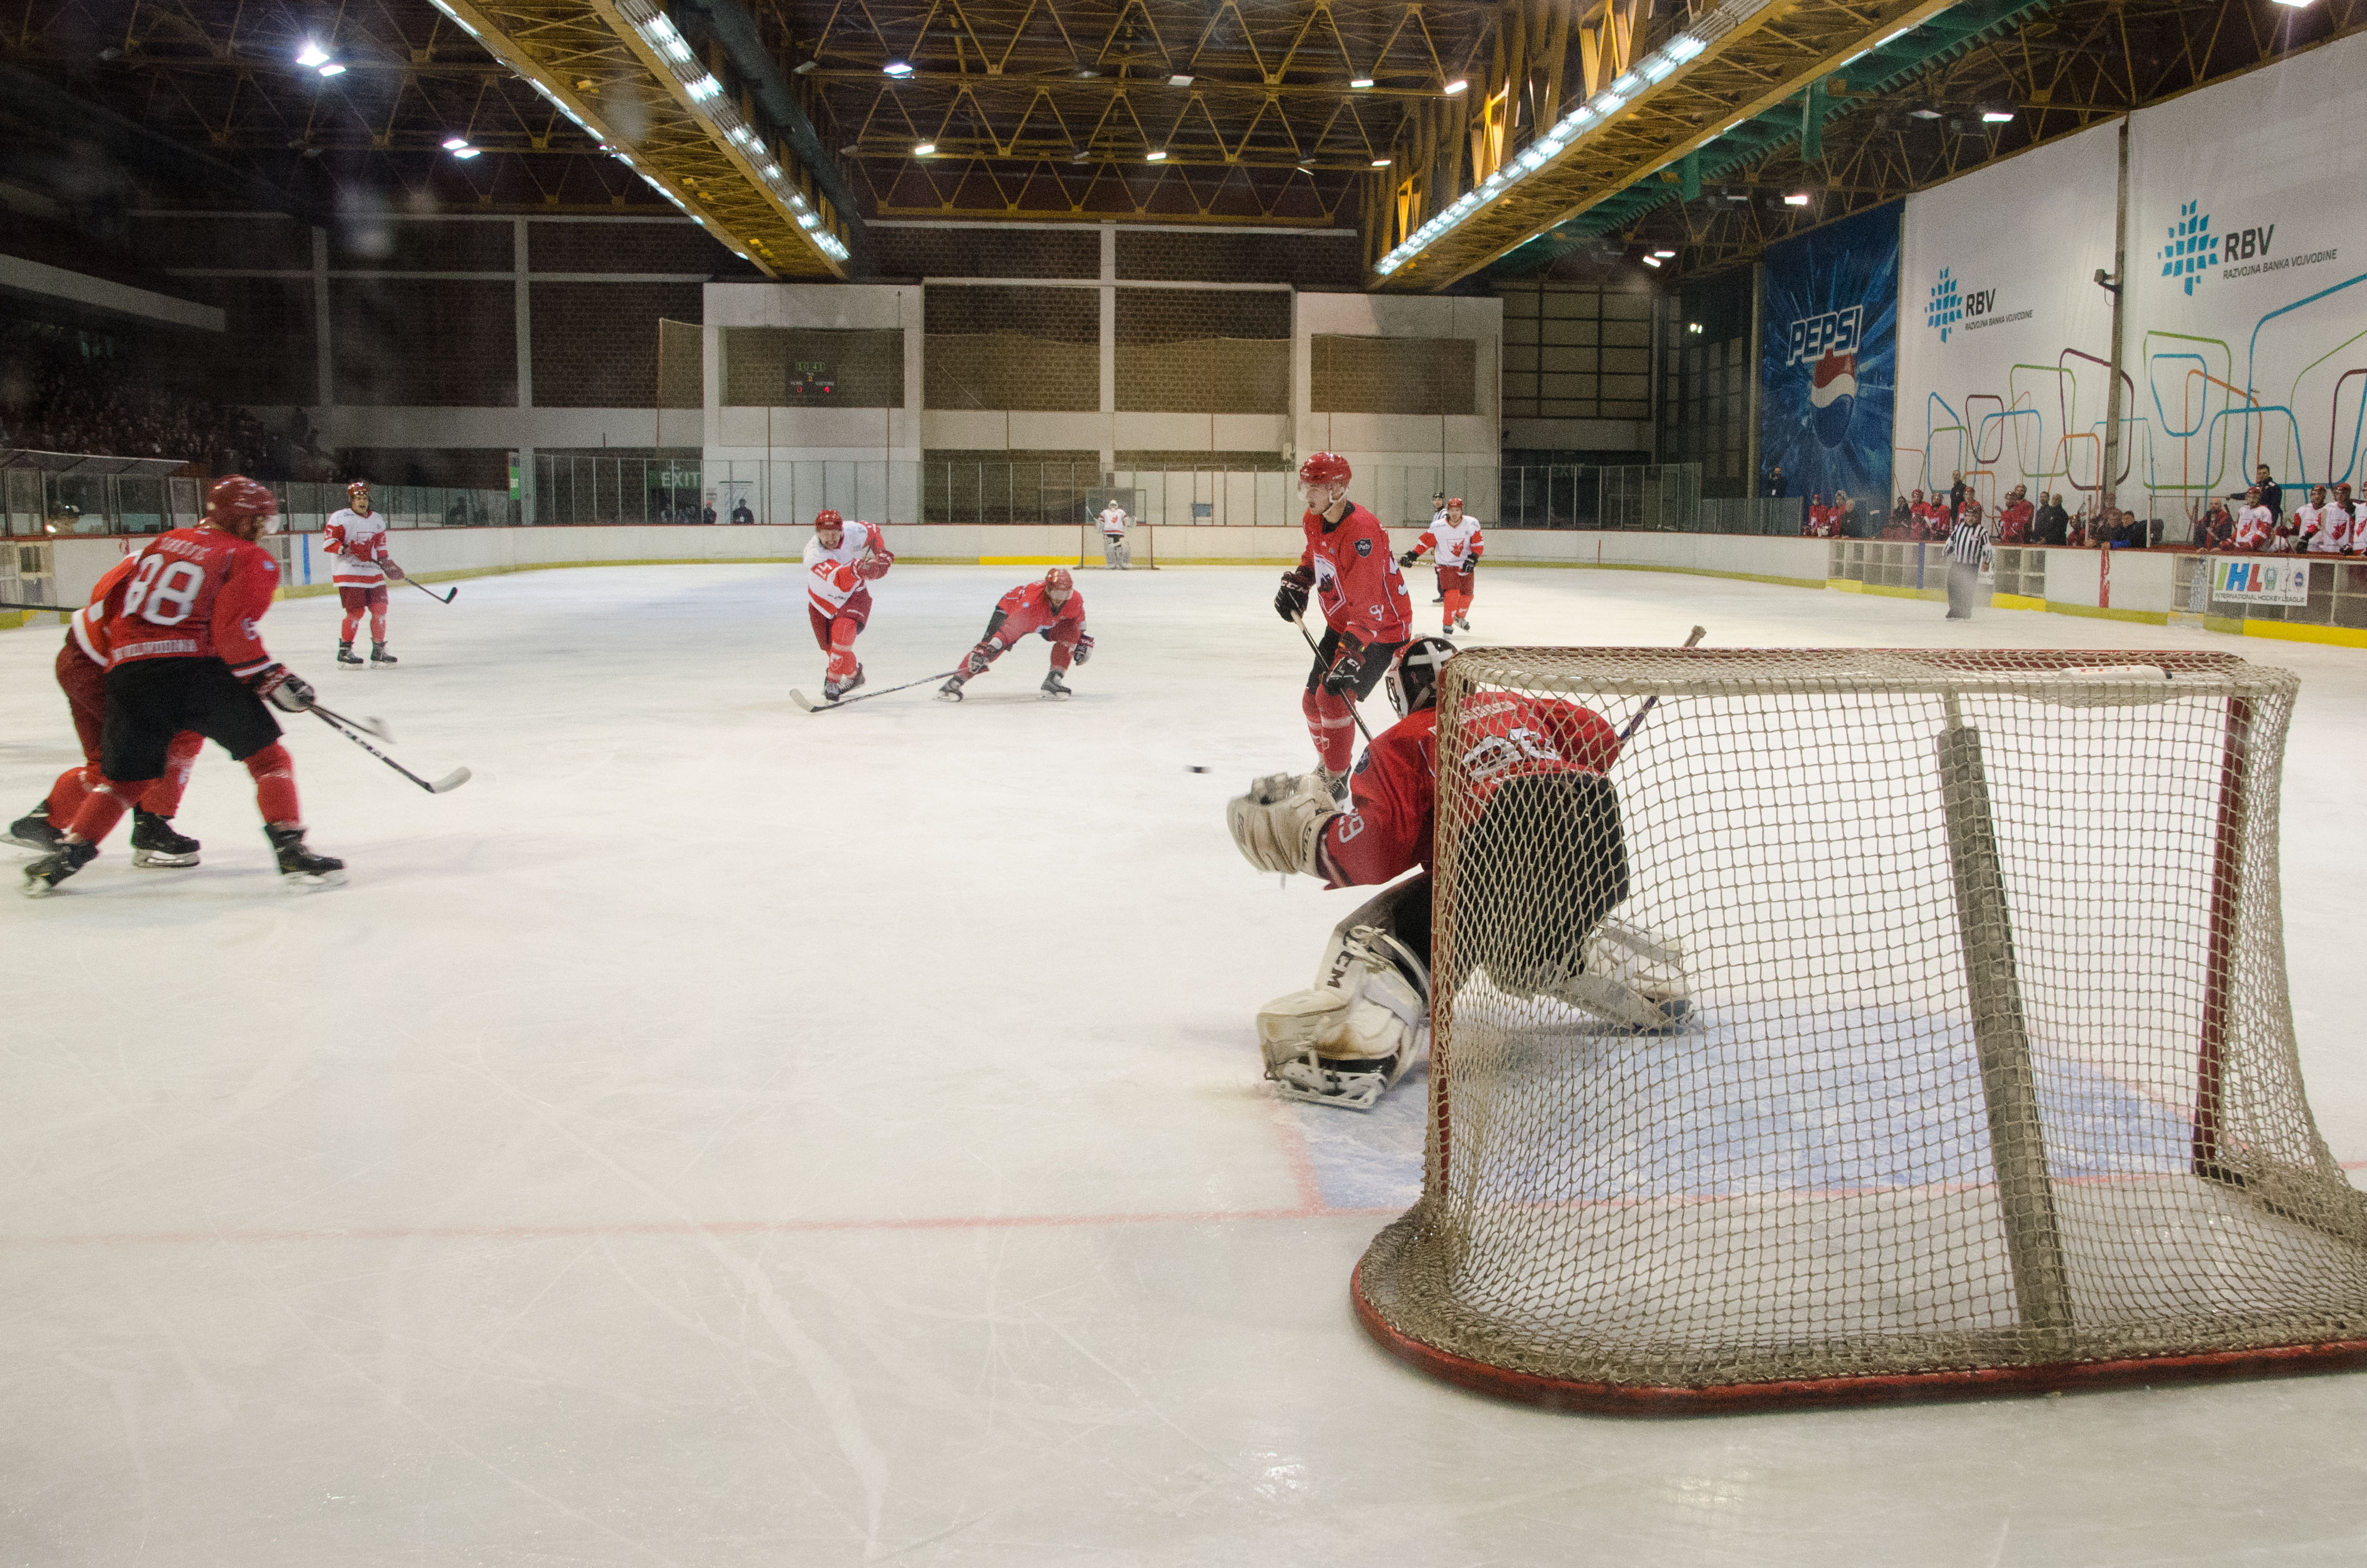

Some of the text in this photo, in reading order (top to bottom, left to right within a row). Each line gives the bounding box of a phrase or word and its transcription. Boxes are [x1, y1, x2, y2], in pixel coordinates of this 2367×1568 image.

[2225, 224, 2275, 263] RBV
[2223, 249, 2337, 279] RAZVOJNA BANKA VOJVODINE
[1966, 288, 1996, 317] RBV
[1965, 309, 2033, 331] RAZVOJNA BANKA VOJVODINE
[1787, 305, 1862, 366] PEPSI
[662, 472, 701, 487] EXIT
[815, 561, 832, 578] 14
[2216, 563, 2262, 592] IHL
[122, 553, 206, 626] 88
